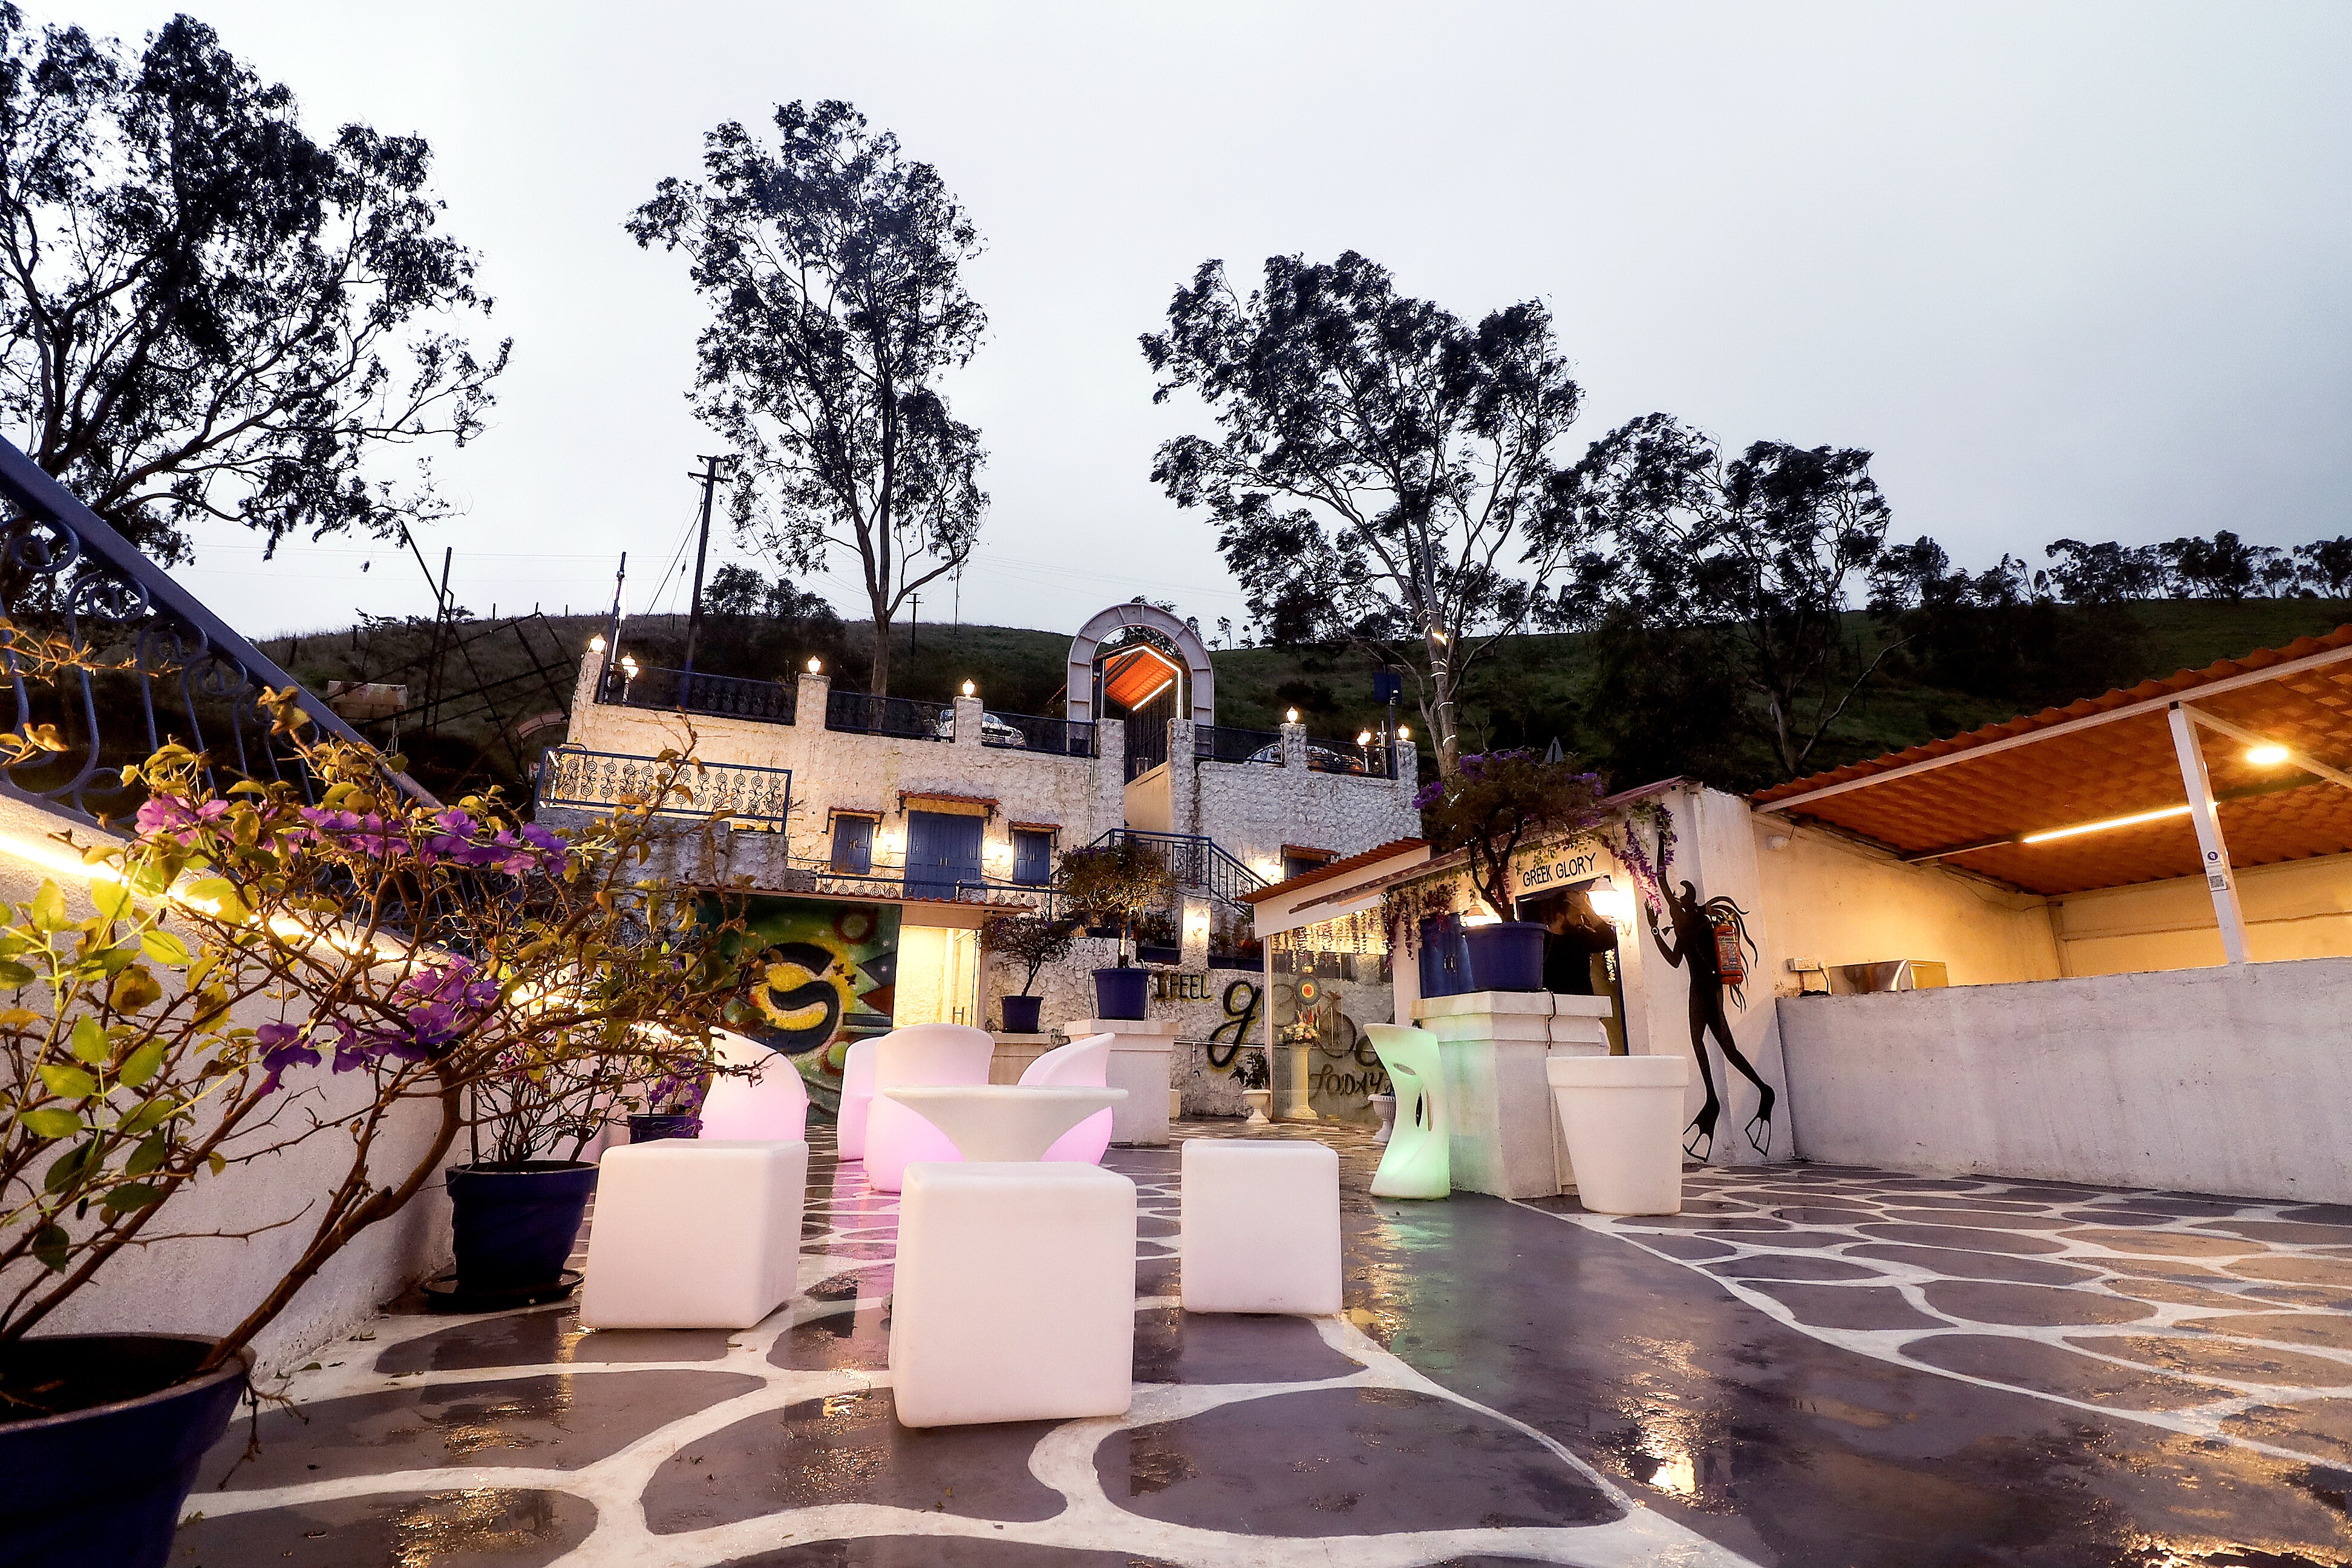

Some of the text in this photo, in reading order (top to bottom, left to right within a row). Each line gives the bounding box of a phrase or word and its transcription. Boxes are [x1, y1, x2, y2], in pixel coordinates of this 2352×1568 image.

[1523, 852, 1596, 887] GREEK GLORY
[1169, 973, 1212, 999] FEEL
